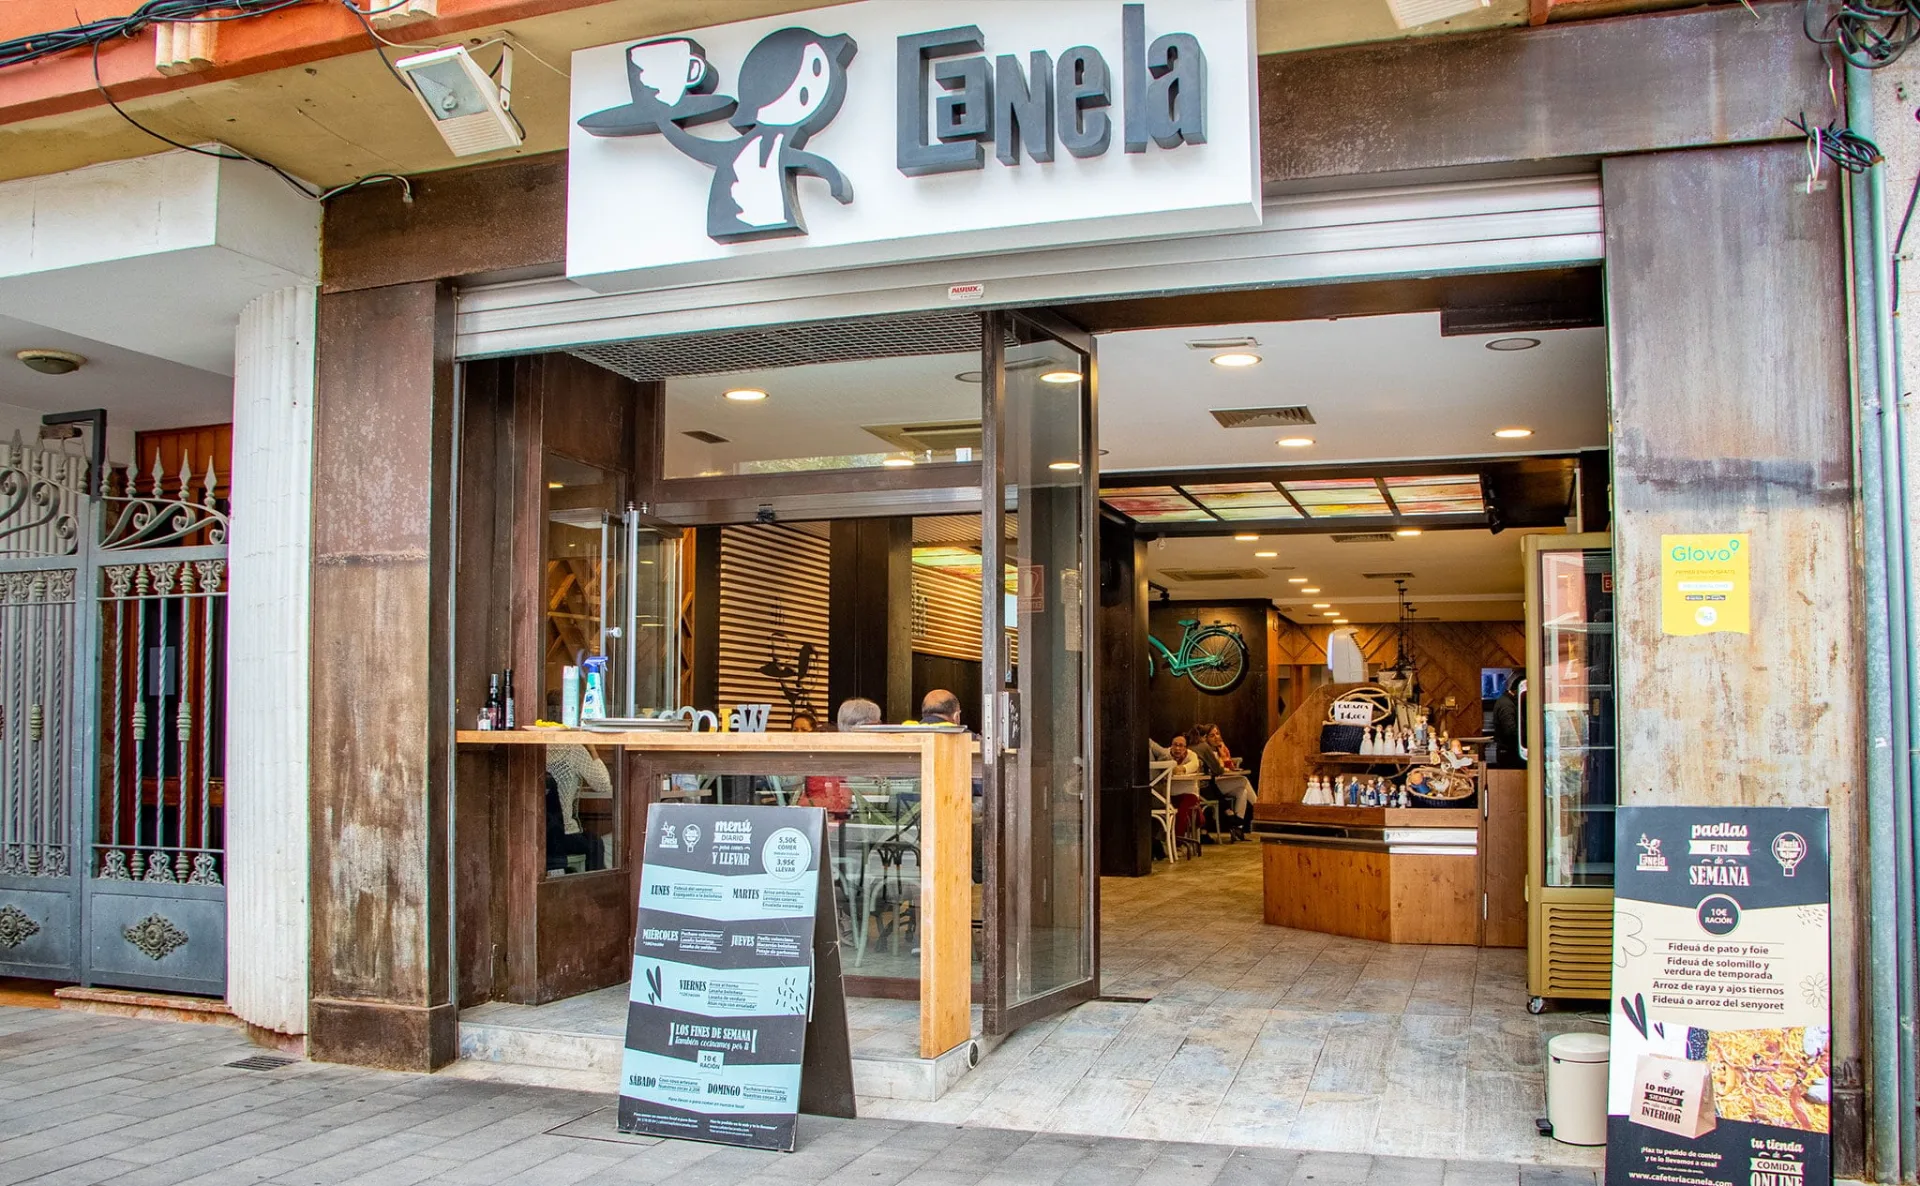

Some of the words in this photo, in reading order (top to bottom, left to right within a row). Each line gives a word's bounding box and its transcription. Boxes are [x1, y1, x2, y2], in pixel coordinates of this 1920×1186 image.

[1671, 545, 1732, 562] Glovo
[715, 819, 752, 832] menú
[1691, 823, 1748, 838] paellas
[721, 834, 744, 842] DIARIO
[1710, 844, 1728, 852] FIN
[712, 852, 718, 865] Y
[719, 852, 750, 866] LLEVAR
[1714, 856, 1724, 864] de
[1689, 866, 1750, 886] SEMANA
[651, 885, 670, 896] LUNES
[732, 888, 760, 899] MARTES
[1711, 908, 1728, 916] 10€
[1705, 916, 1733, 924] RACIÓN
[642, 928, 678, 941] MIÉRCOLES
[730, 935, 755, 946] JUEVES
[1668, 942, 1700, 952] Fideuá
[1702, 944, 1715, 952] de
[1717, 945, 1740, 954] pato
[1750, 946, 1769, 954] foie
[1668, 957, 1700, 966] Fideuá
[1702, 958, 1714, 966] de
[1716, 960, 1762, 968] solomillo
[1764, 962, 1770, 970] y
[1664, 968, 1701, 976] verdura
[1704, 968, 1716, 976] de
[1718, 970, 1772, 980] temporada
[680, 980, 706, 991] VIERNES
[1652, 980, 1678, 989] Arroz
[1681, 982, 1694, 990] de
[1696, 984, 1716, 993] raya
[1718, 986, 1724, 994] y
[1726, 985, 1747, 994] ajos
[1749, 985, 1784, 995] tiernos
[1652, 996, 1685, 1004] Fideuá
[1696, 998, 1720, 1006] arroz
[1722, 998, 1738, 1007] del
[1741, 1000, 1784, 1010] senyoret
[676, 1024, 689, 1036] LOS
[690, 1026, 710, 1038] FINES
[711, 1027, 722, 1038] DE
[723, 1028, 751, 1041] SEMANA
[675, 1036, 699, 1046] También
[700, 1039, 731, 1050] cocinamos
[629, 1073, 656, 1088] SÁBADO
[708, 1083, 740, 1096] DOMINGO
[1658, 1085, 1684, 1097] mejor
[1648, 1094, 1679, 1104] SIEMPRE
[1642, 1106, 1681, 1124] INTERIOR
[1750, 1138, 1765, 1149] tu
[1766, 1139, 1804, 1152] tienda
[1664, 1148, 1686, 1156] pedido
[1698, 1152, 1722, 1160] comida
[1666, 1157, 1694, 1166] llevamos
[1757, 1161, 1796, 1172] COMIDA
[1628, 1172, 1733, 1186] www.cafeteriacanela.com
[1750, 1172, 1803, 1186] ONLINE
